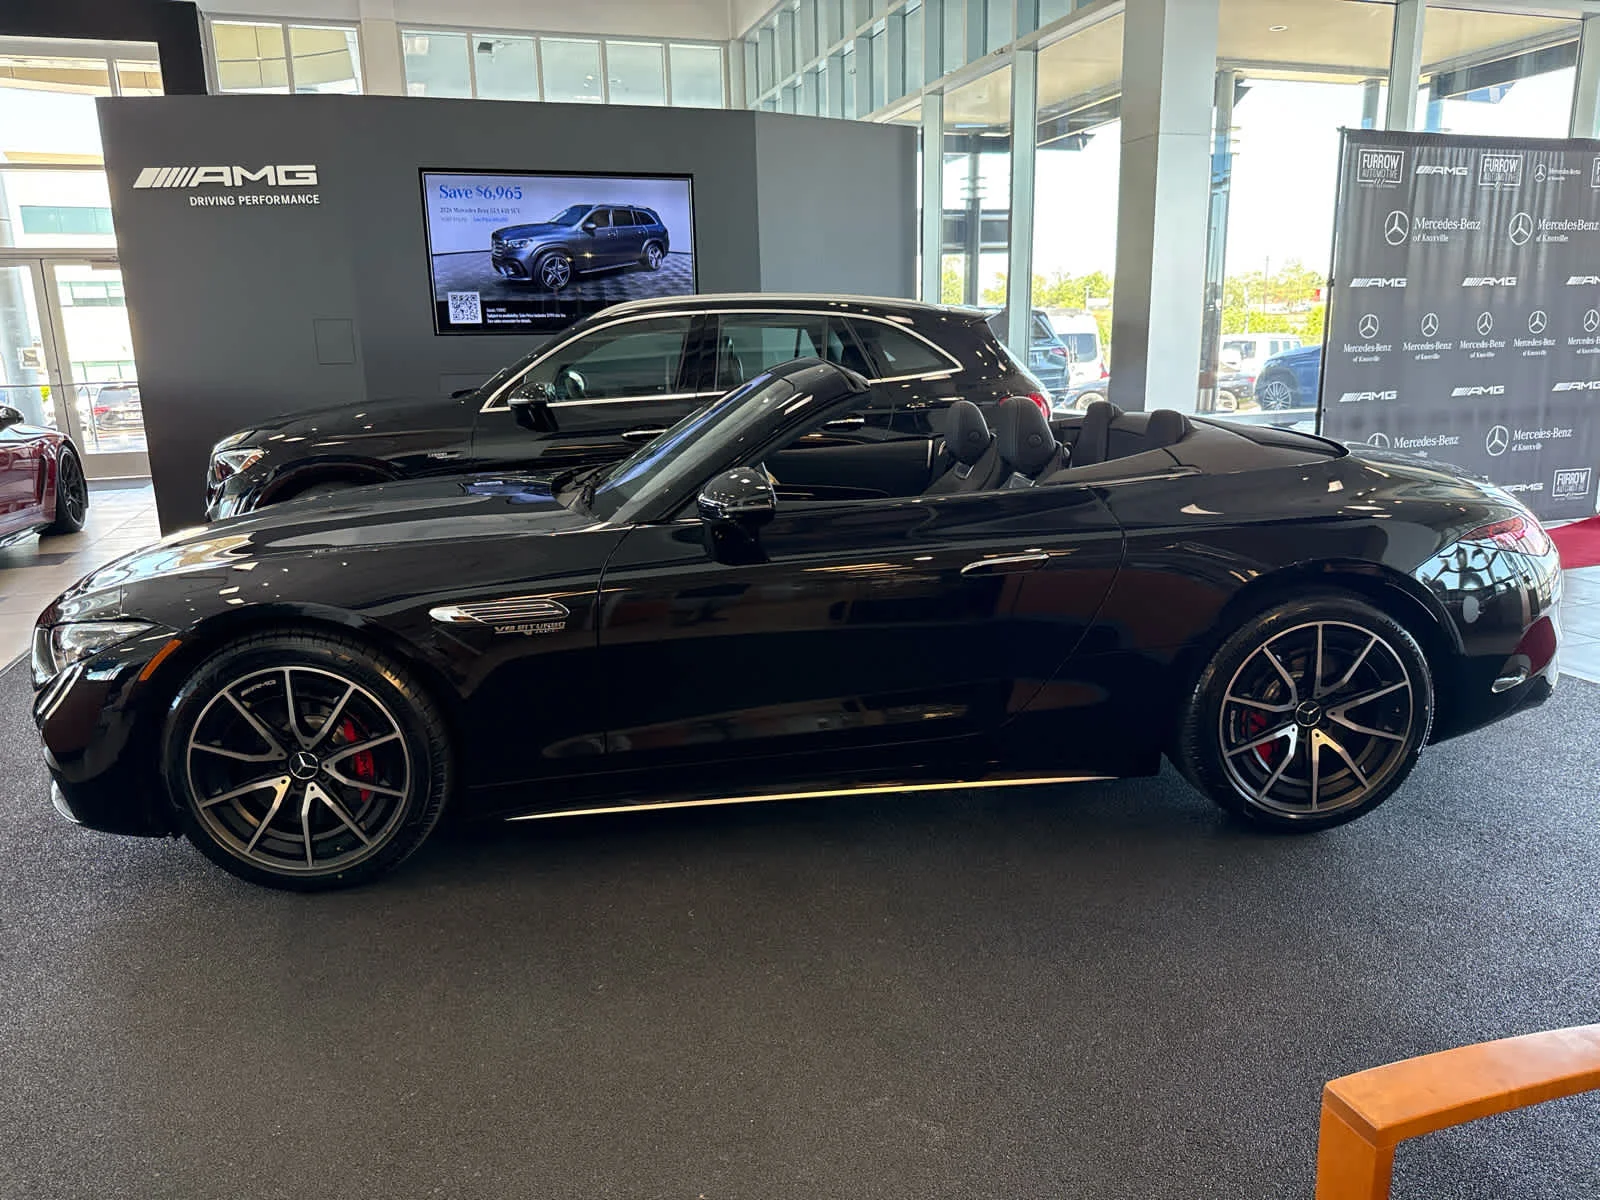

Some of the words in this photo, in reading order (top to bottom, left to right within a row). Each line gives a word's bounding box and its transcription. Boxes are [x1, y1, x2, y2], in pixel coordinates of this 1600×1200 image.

[1362, 153, 1400, 169] FURROW
[1483, 158, 1519, 173] FURROW
[187, 165, 318, 187] AMG
[1430, 166, 1468, 176] AMG
[439, 184, 473, 200] Save
[475, 185, 522, 200] $6,965
[190, 195, 235, 206] DRIVING
[239, 194, 320, 206] PERFORMANCE
[1414, 217, 1481, 231] Mercedes-Benz
[1537, 218, 1600, 231] MercedesBenz
[1366, 278, 1407, 288] AMG
[1479, 277, 1517, 287] AMG
[1343, 343, 1392, 353] Mercedes-Benz
[1402, 340, 1453, 352] Mercedes-Benz
[1359, 390, 1397, 401] AMG
[1468, 385, 1504, 396] AMG
[1513, 427, 1573, 441] Mercedes-Benz
[1394, 434, 1459, 449] Mercedes-Benz
[1511, 483, 1544, 492] AMG
